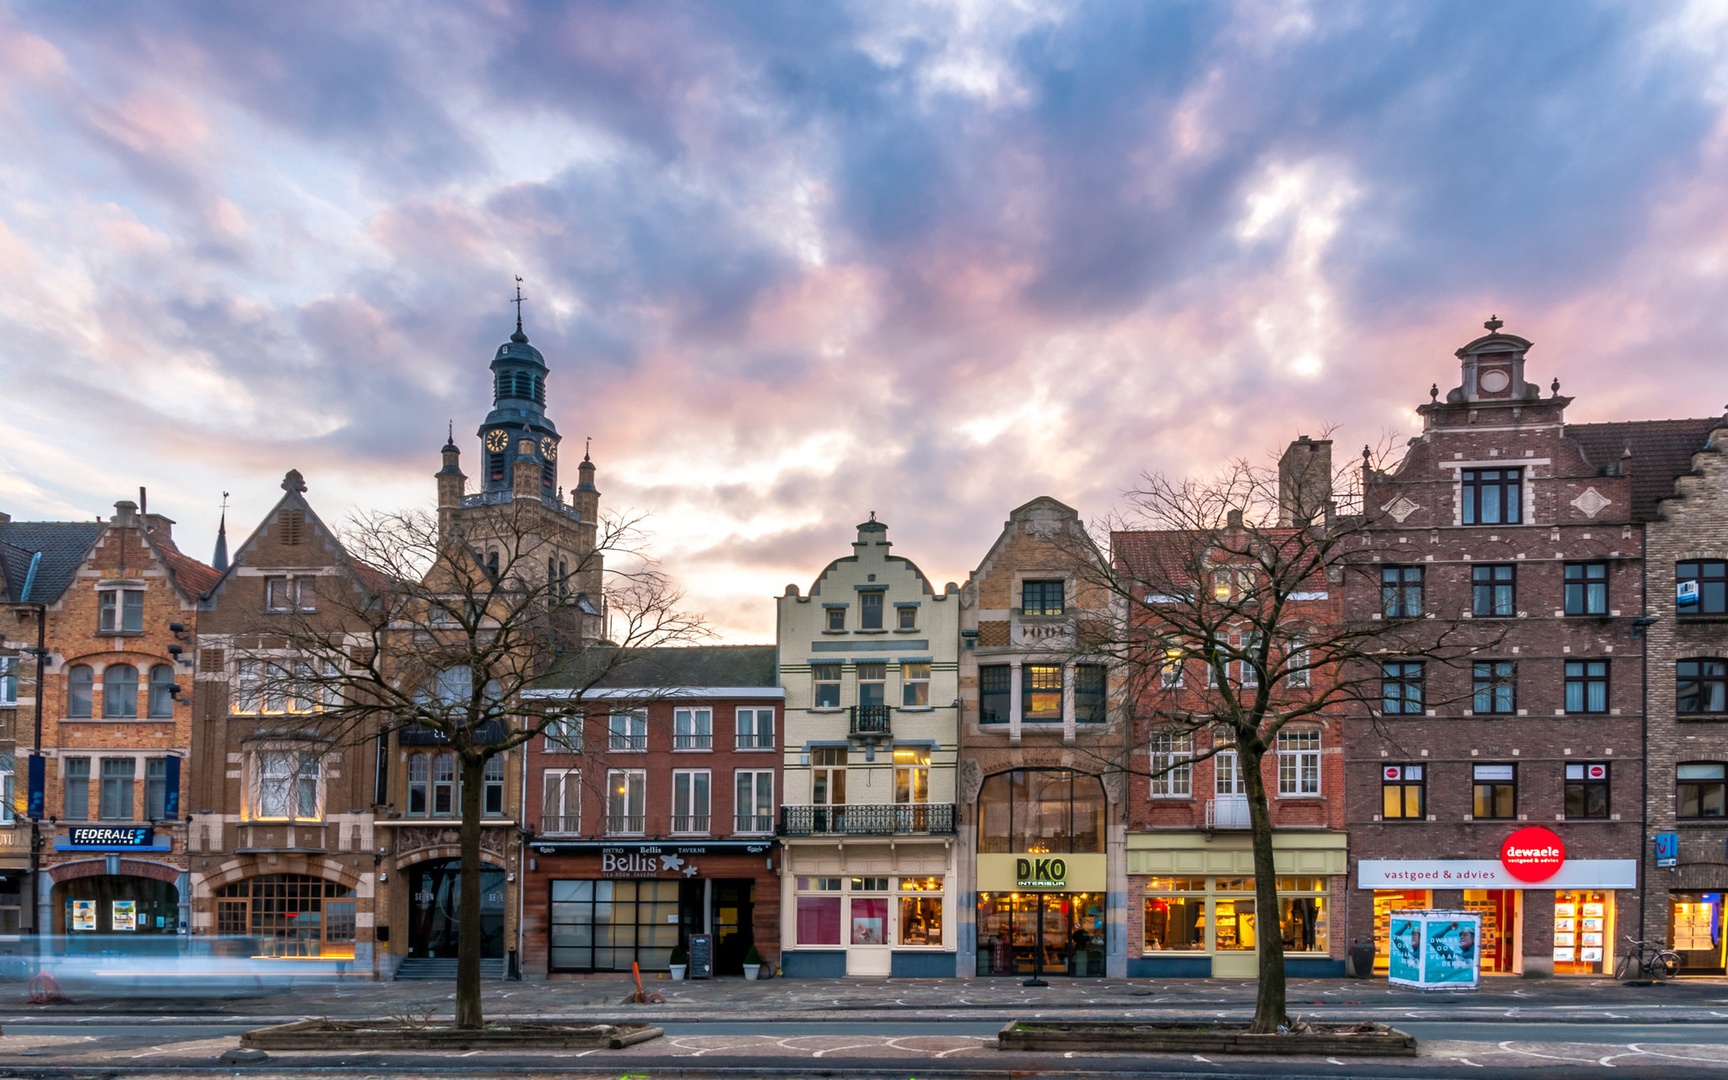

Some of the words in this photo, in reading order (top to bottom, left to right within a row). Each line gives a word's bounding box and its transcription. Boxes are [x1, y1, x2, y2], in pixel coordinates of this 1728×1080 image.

[75, 829, 135, 839] FEDERALE
[1507, 846, 1559, 857] dewaele
[601, 853, 657, 871] Bellis
[1384, 870, 1439, 881] vastgoed
[1443, 870, 1452, 879] &
[1456, 870, 1495, 879] advies
